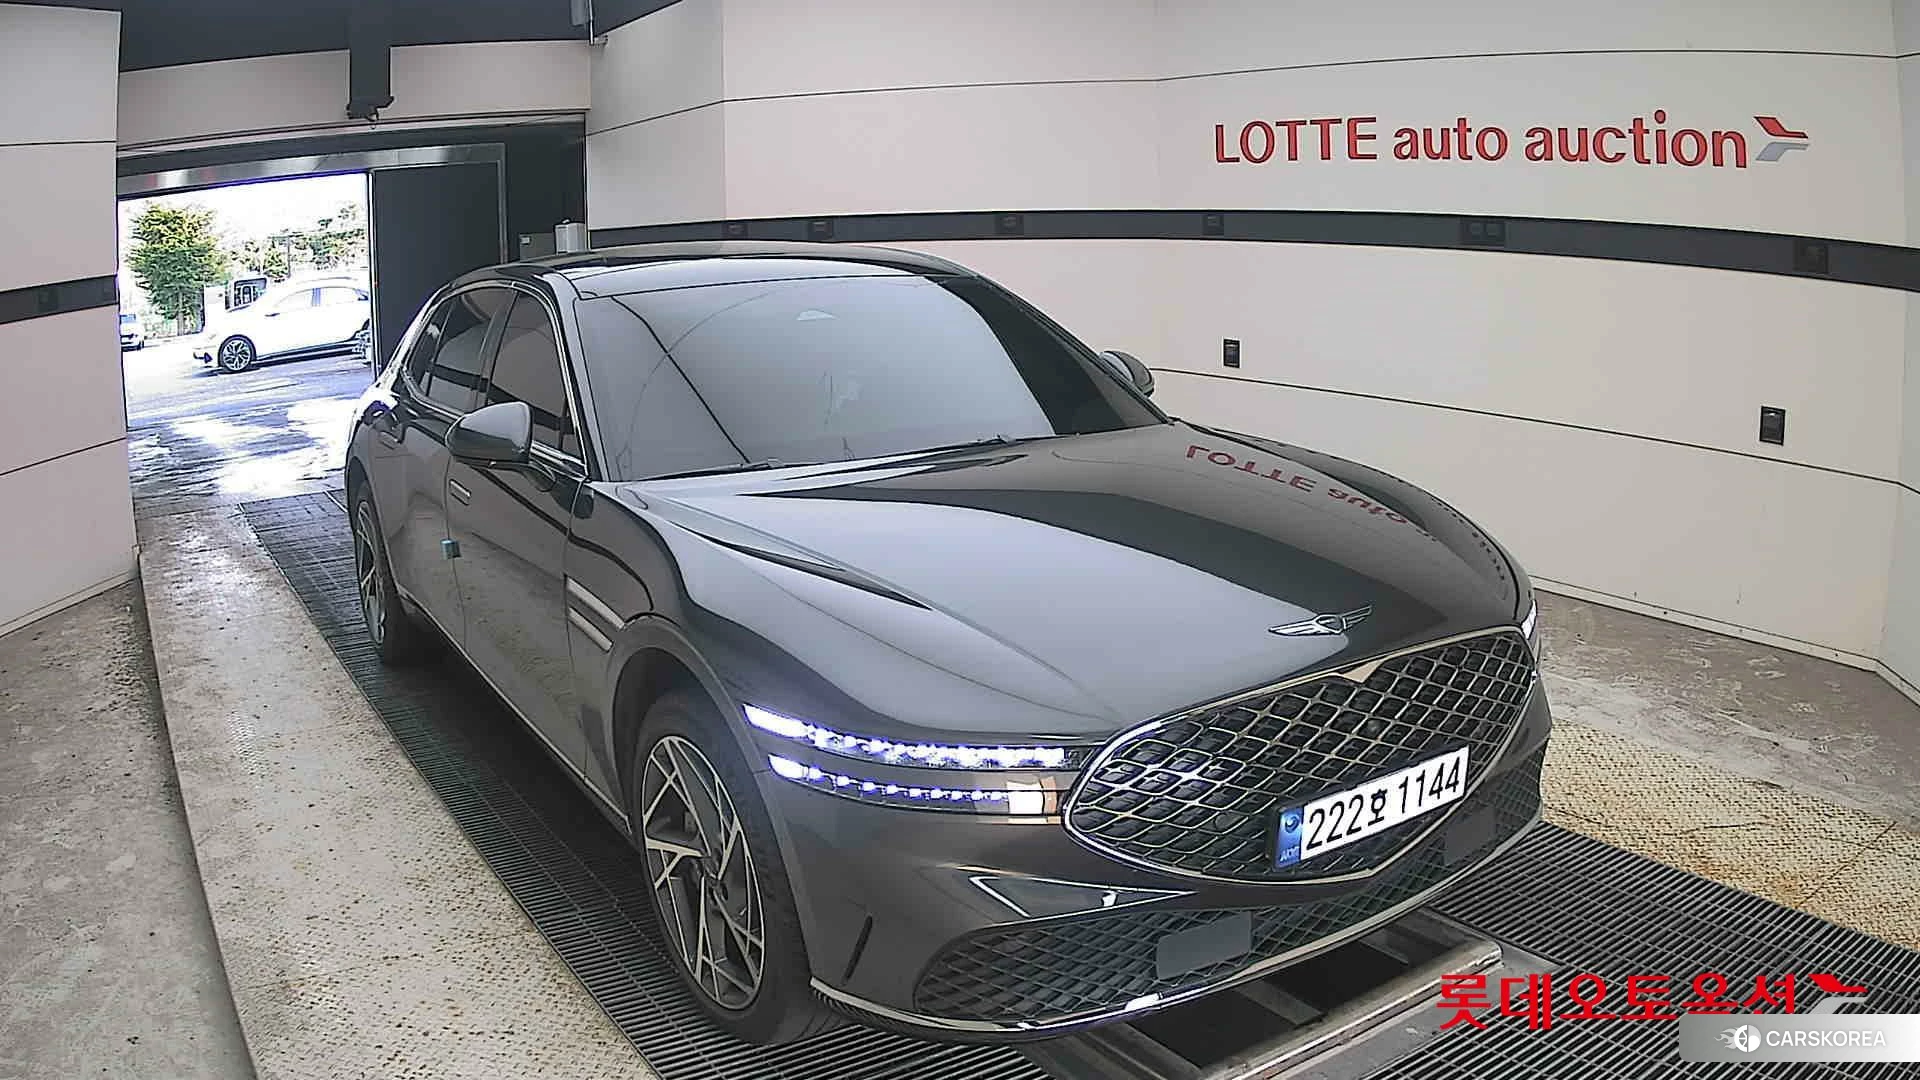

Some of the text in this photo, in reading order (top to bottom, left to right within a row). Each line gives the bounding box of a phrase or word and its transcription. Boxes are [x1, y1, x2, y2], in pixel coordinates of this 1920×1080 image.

[1216, 111, 1748, 168] LOTTE auto auction
[1398, 756, 1460, 814] 1144
